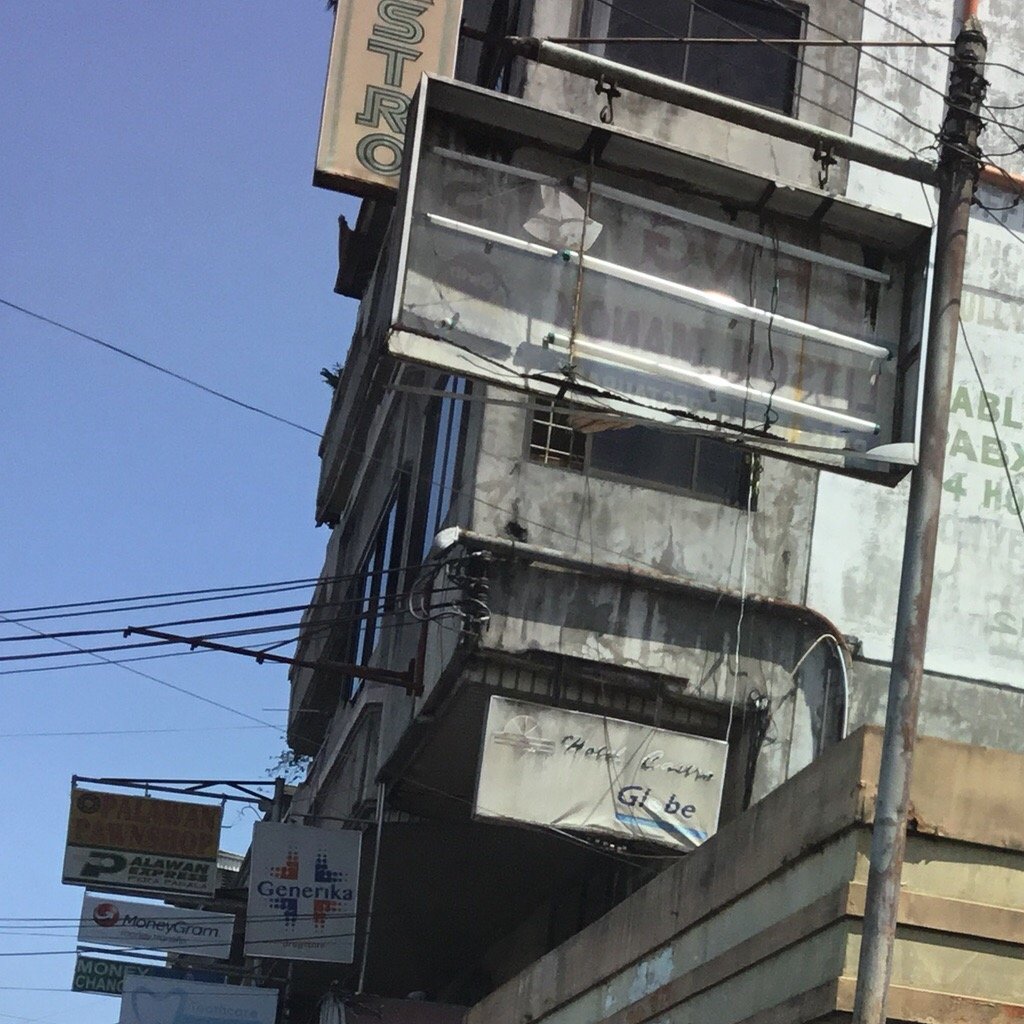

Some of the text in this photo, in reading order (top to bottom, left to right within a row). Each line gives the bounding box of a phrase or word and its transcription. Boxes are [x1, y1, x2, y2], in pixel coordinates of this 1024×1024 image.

[355, 0, 431, 175] STRO
[256, 880, 353, 901] Generika
[121, 914, 219, 938] MoneyGram
[77, 960, 149, 977] MONEY
